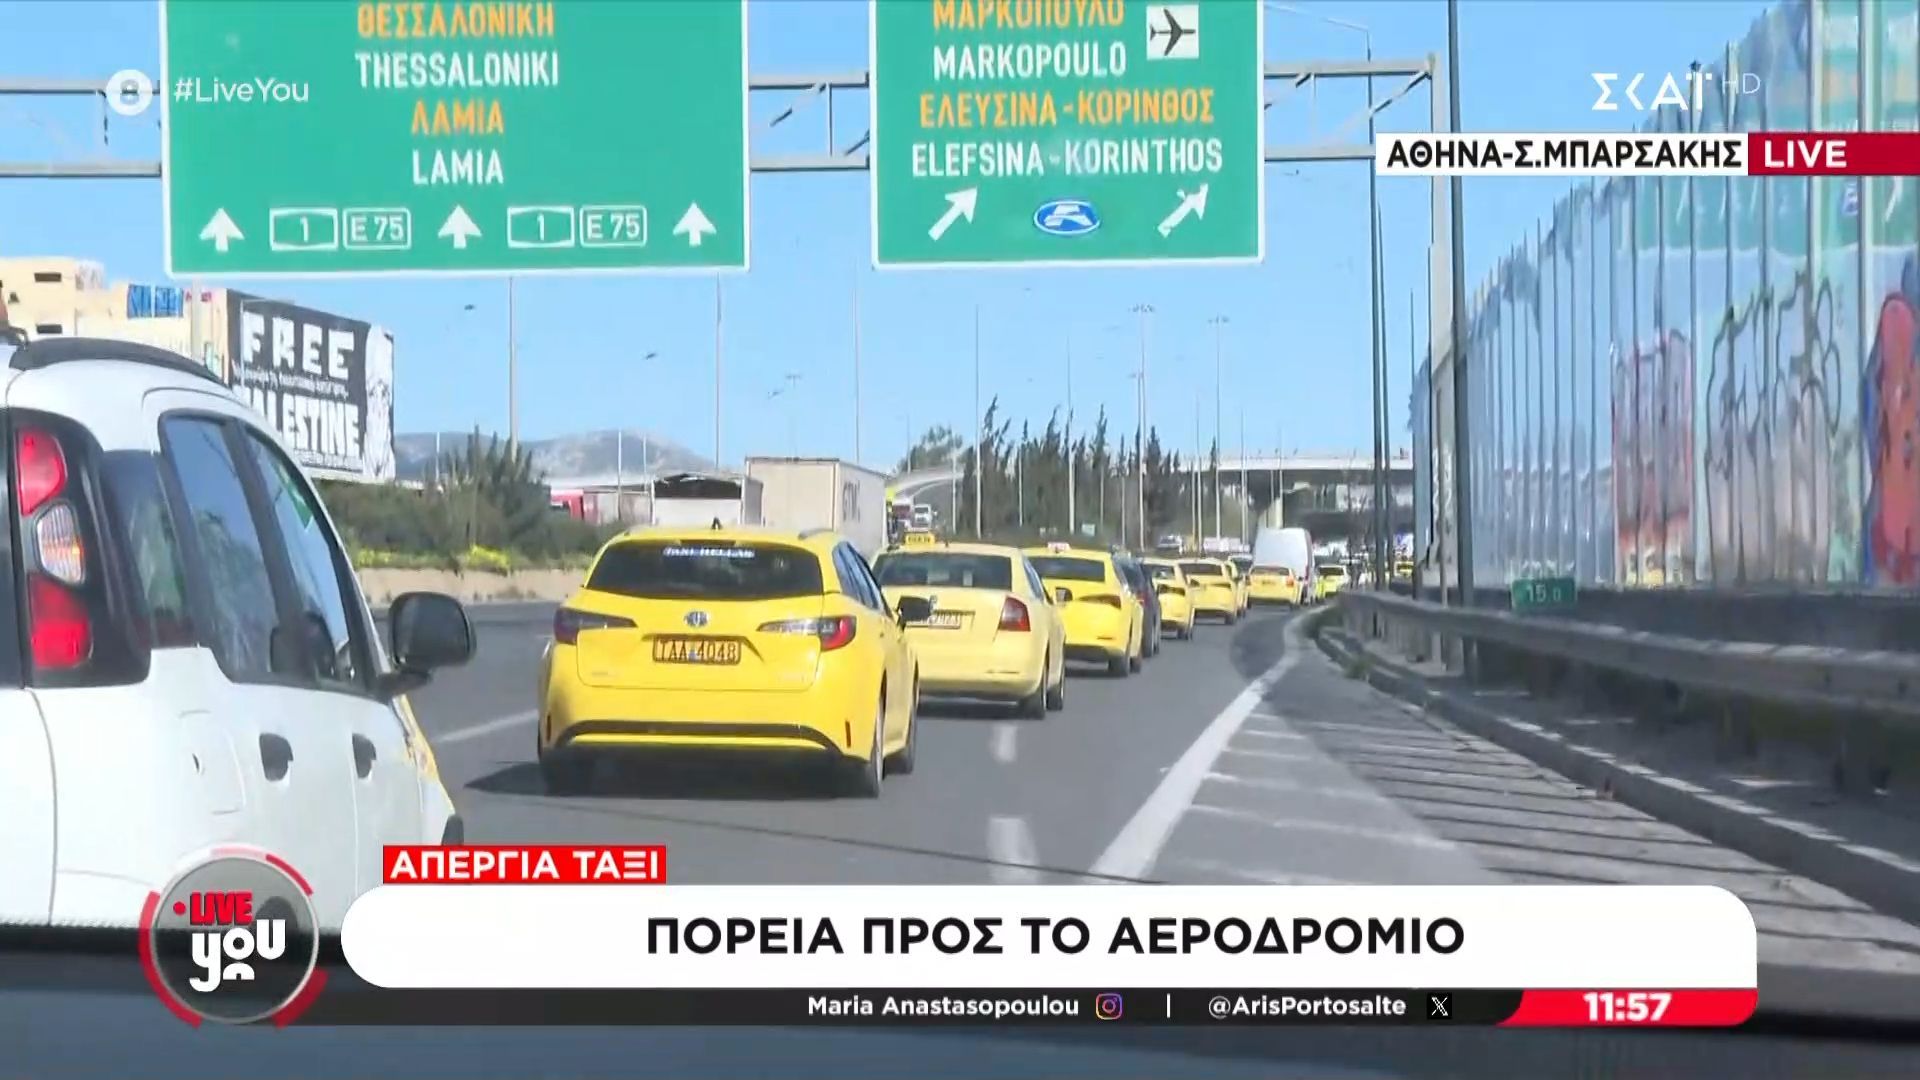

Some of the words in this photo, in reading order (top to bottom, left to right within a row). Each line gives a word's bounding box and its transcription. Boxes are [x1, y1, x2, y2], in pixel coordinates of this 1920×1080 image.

[357, 3, 555, 39] ΘΕΣΣΑΛΟΝΙΚΗ
[933, 0, 1125, 28] ΜΑΡΚΟΠΟΥΛΟ
[354, 51, 559, 88] THESSALONIKI
[933, 40, 1127, 80] MARKOPOULO
[411, 100, 505, 135] ΛΑΜΙΑ
[919, 91, 1057, 128] ΕΛΕΥΣΙΝΑ
[1078, 88, 1214, 124] ΚΟΡΙΝΘΟΣ
[412, 149, 505, 185] LAMIA
[912, 142, 1044, 177] ELEFSINA
[1065, 137, 1223, 175] KORINTHOS
[300, 214, 310, 242] 1
[350, 215, 367, 241] E
[375, 214, 405, 241] 75
[537, 213, 546, 241] 1
[586, 214, 604, 239] E
[610, 213, 641, 239] 75
[242, 311, 355, 381] FREE
[696, 639, 738, 662] 4048
